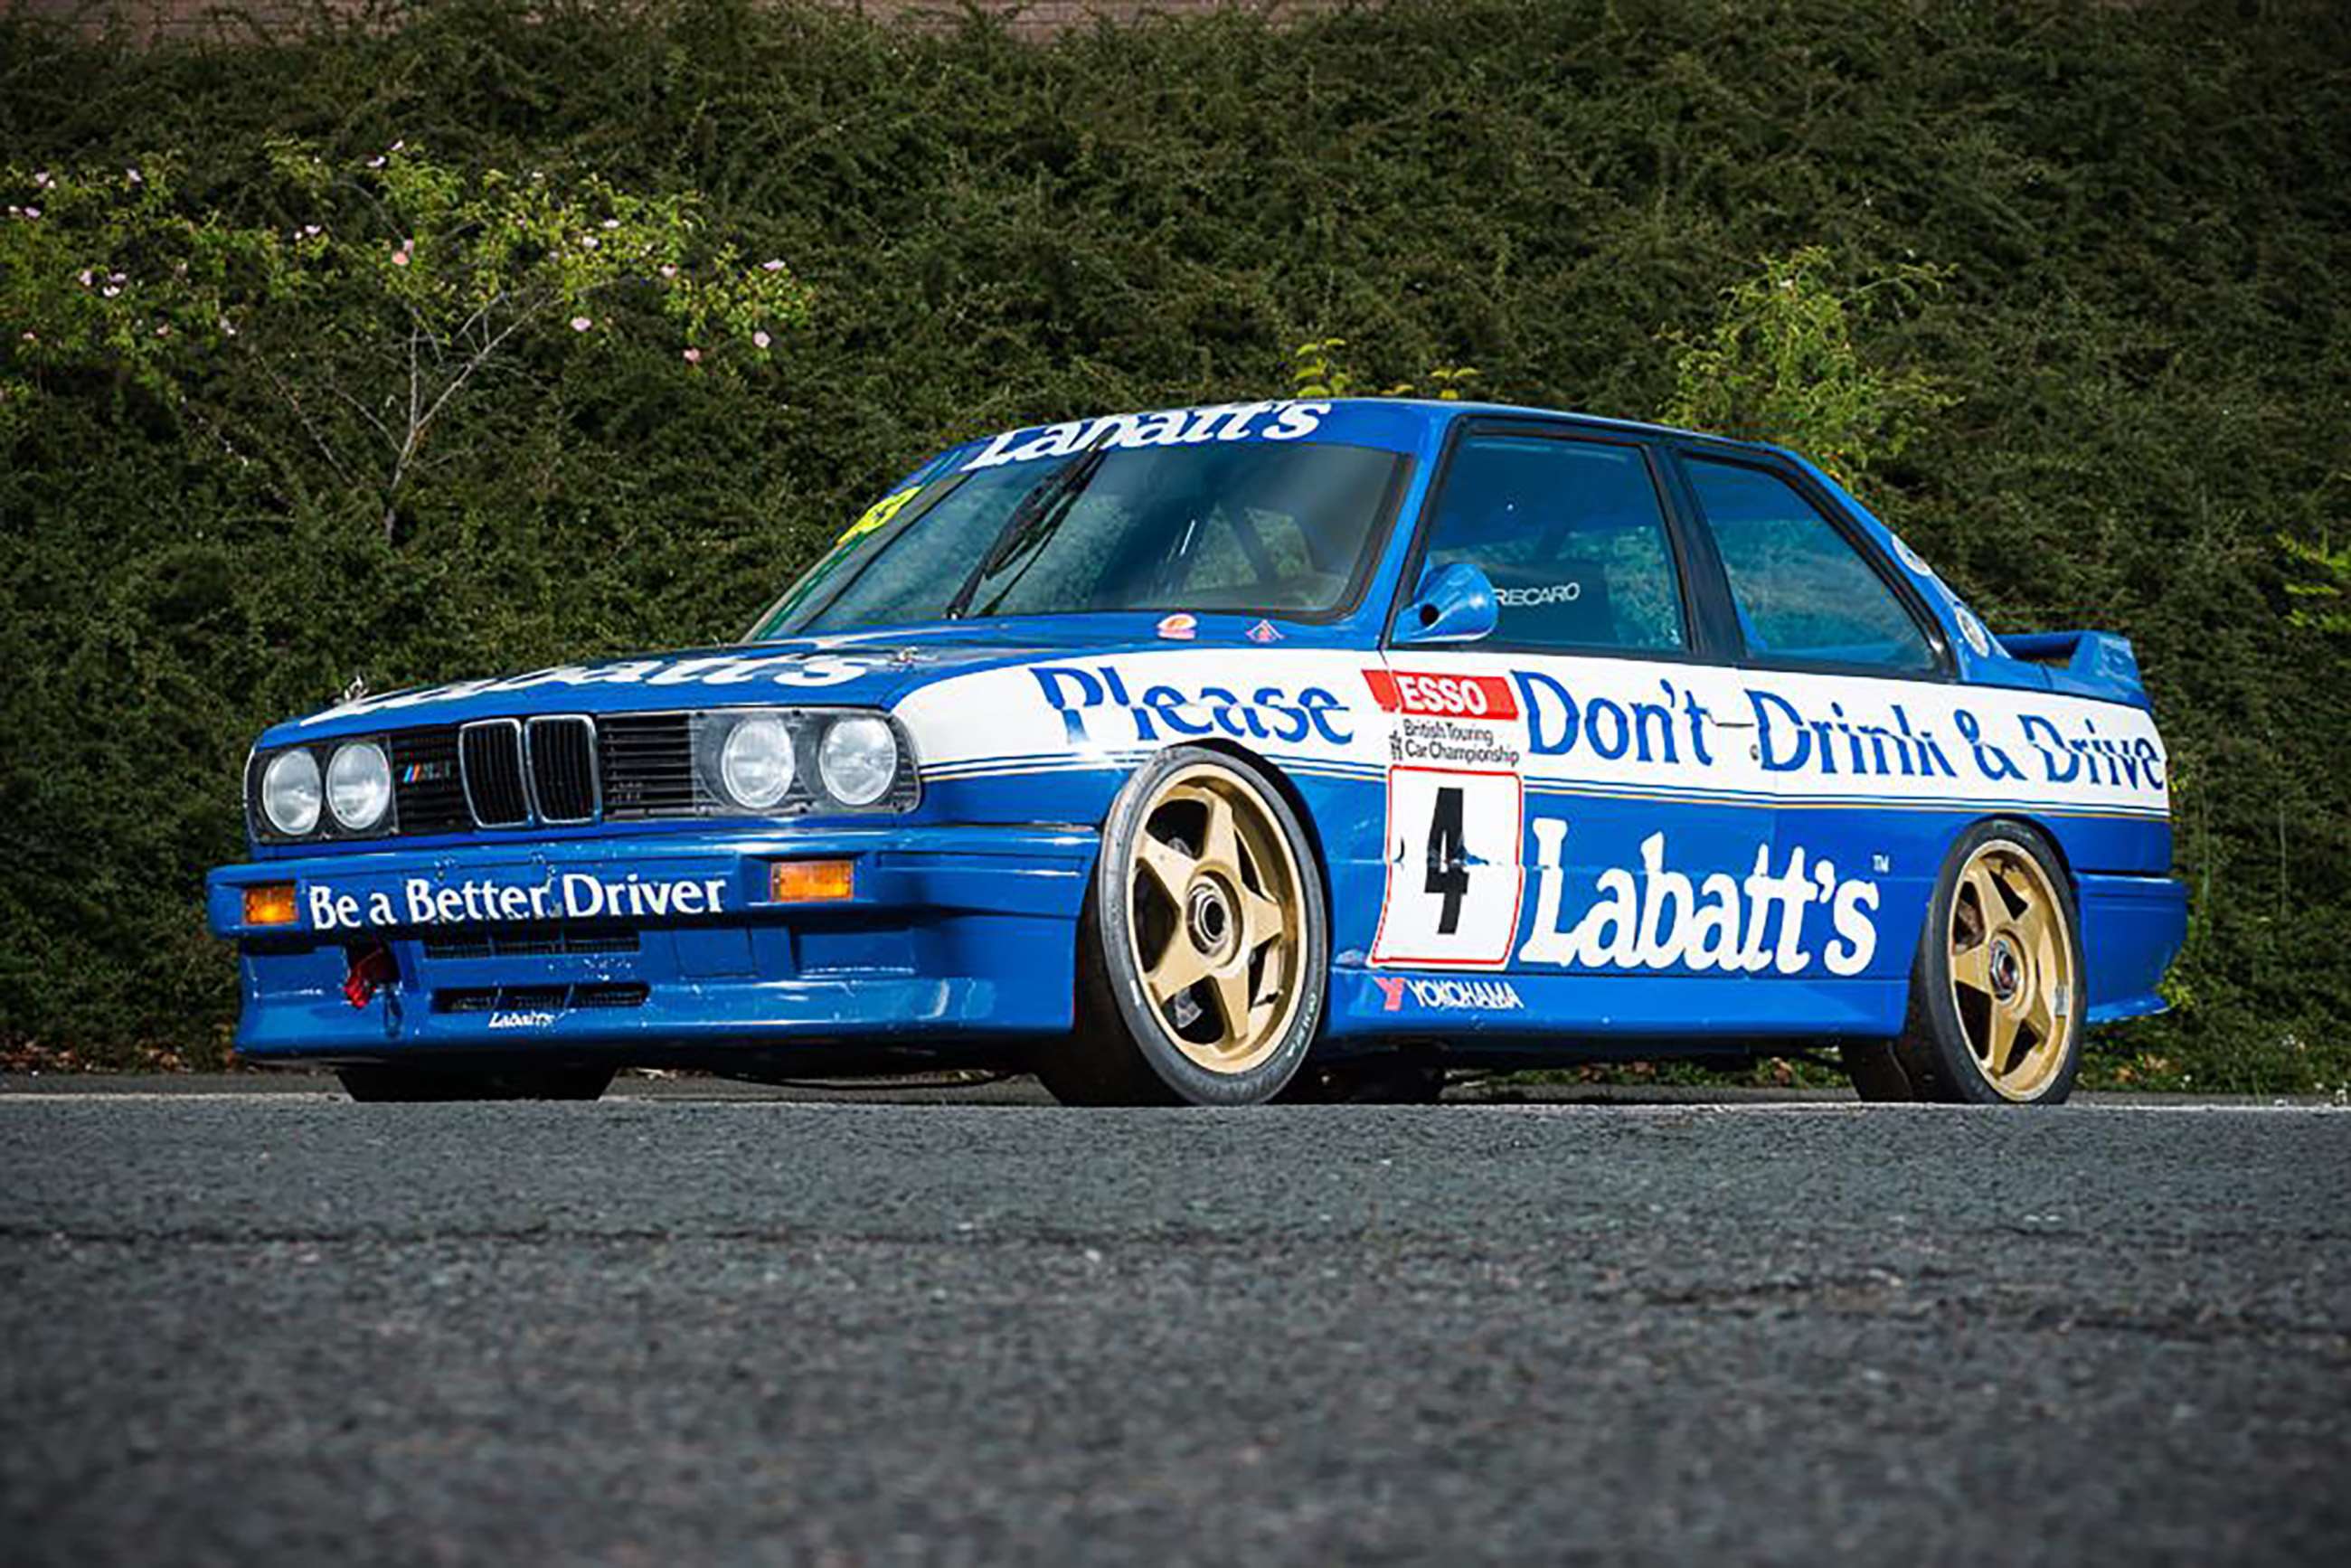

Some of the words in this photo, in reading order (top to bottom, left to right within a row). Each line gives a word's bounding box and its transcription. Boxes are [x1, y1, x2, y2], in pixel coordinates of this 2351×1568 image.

[1492, 582, 1581, 606] RECARO
[1028, 666, 1354, 745] Please
[1395, 676, 1487, 715] ESSO
[1403, 718, 1446, 740] British
[1446, 723, 1494, 747] Touring
[1405, 739, 1427, 758] Car
[1429, 741, 1520, 767] Championship
[1510, 670, 1714, 766] Don't
[1745, 688, 1952, 780] Drink
[1953, 708, 2028, 781] &
[2017, 713, 2165, 791] Drive
[1424, 787, 1470, 935] 4
[308, 884, 361, 930] Be
[369, 889, 398, 926] a
[406, 877, 552, 923] Better
[562, 872, 726, 918] Driver
[1519, 817, 1880, 976] Labatt's
[1406, 979, 1525, 1010] YOKOHAMA
